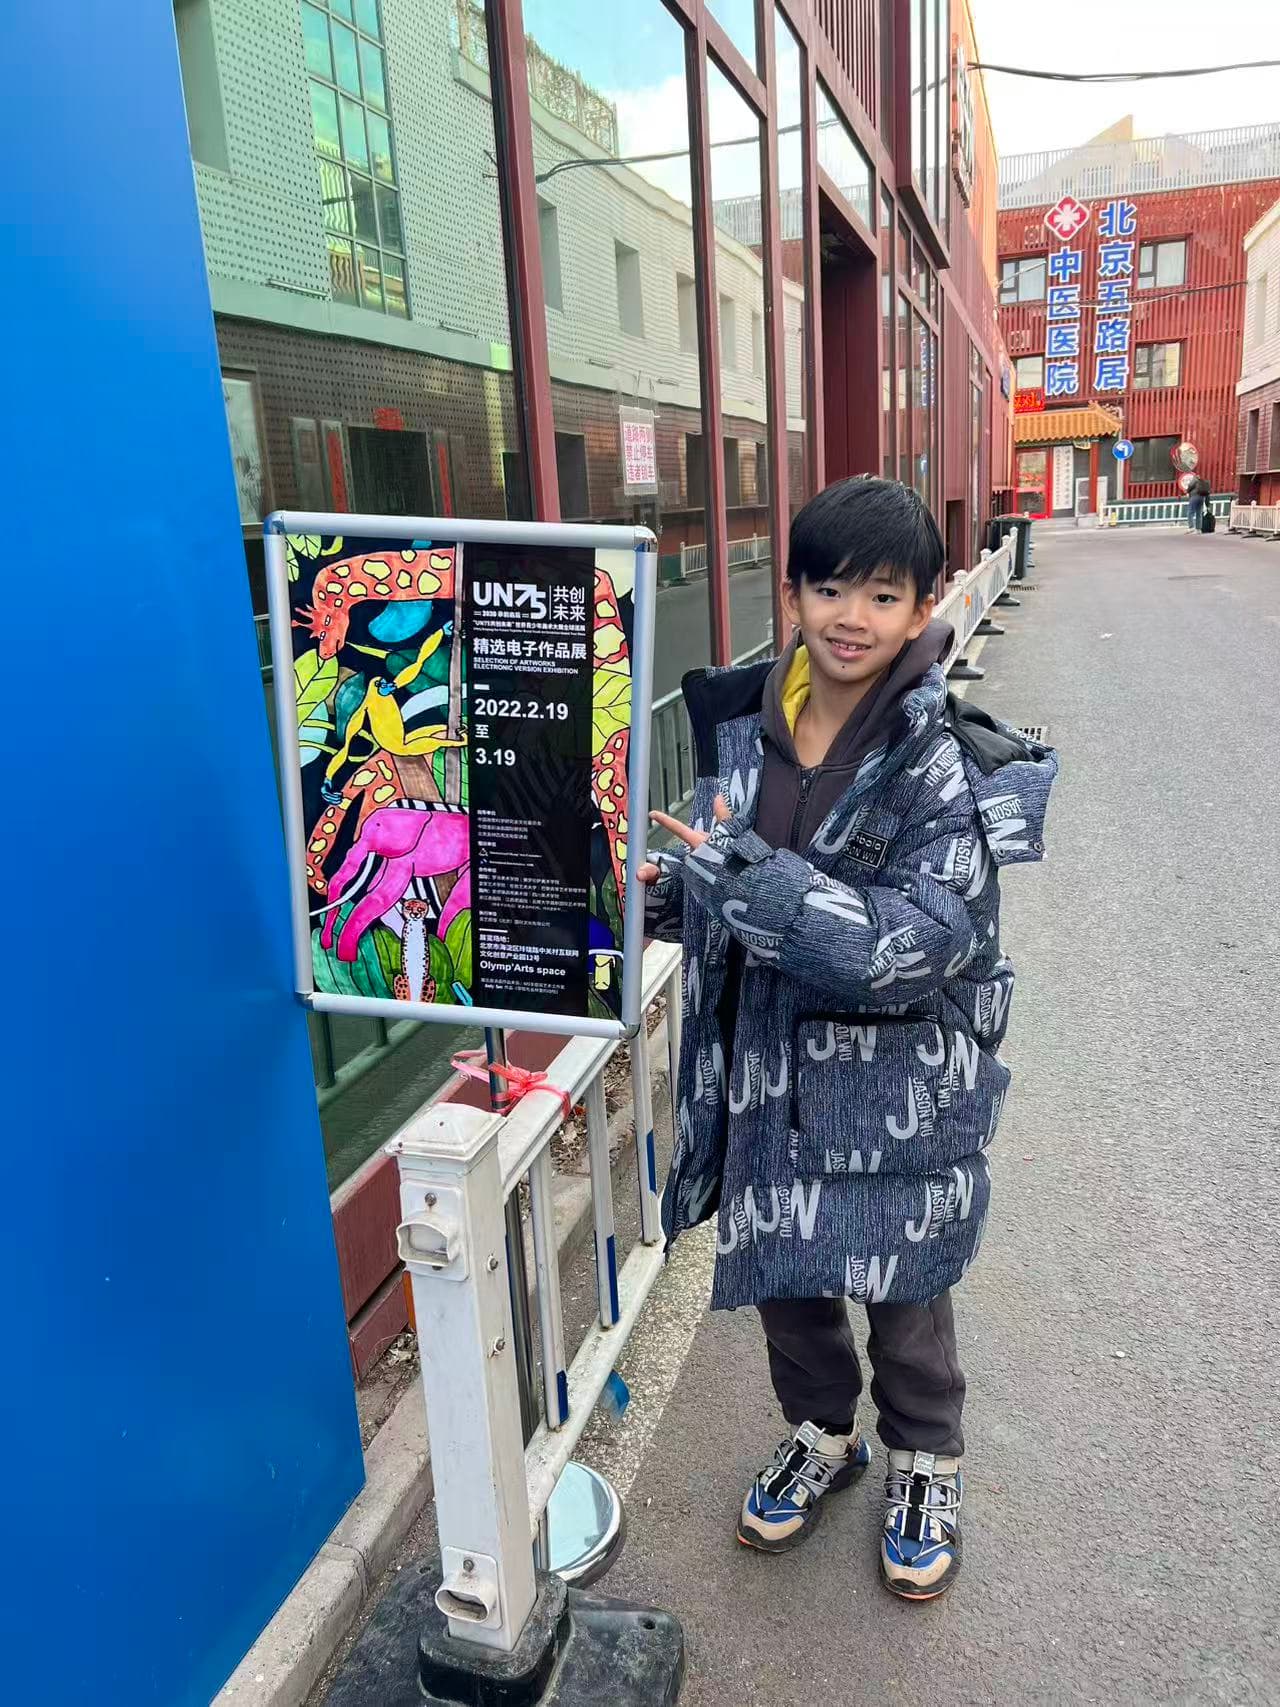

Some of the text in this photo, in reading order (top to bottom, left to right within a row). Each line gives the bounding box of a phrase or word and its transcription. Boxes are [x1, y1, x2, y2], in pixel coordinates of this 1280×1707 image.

[1094, 200, 1137, 391] 北京五路居
[1045, 246, 1082, 396] 中医医院
[473, 581, 547, 619] UN75
[553, 585, 585, 604] 共创
[553, 604, 586, 621] 未来
[473, 638, 587, 659] 精选电子作品展
[474, 657, 508, 665] SELECTION
[474, 664, 579, 675] ELECTRONIC VERSION EXHIBITION
[475, 698, 568, 720] 2022.2.19
[475, 724, 489, 739] 至
[475, 748, 516, 766] 3.19
[537, 966, 566, 977] space
